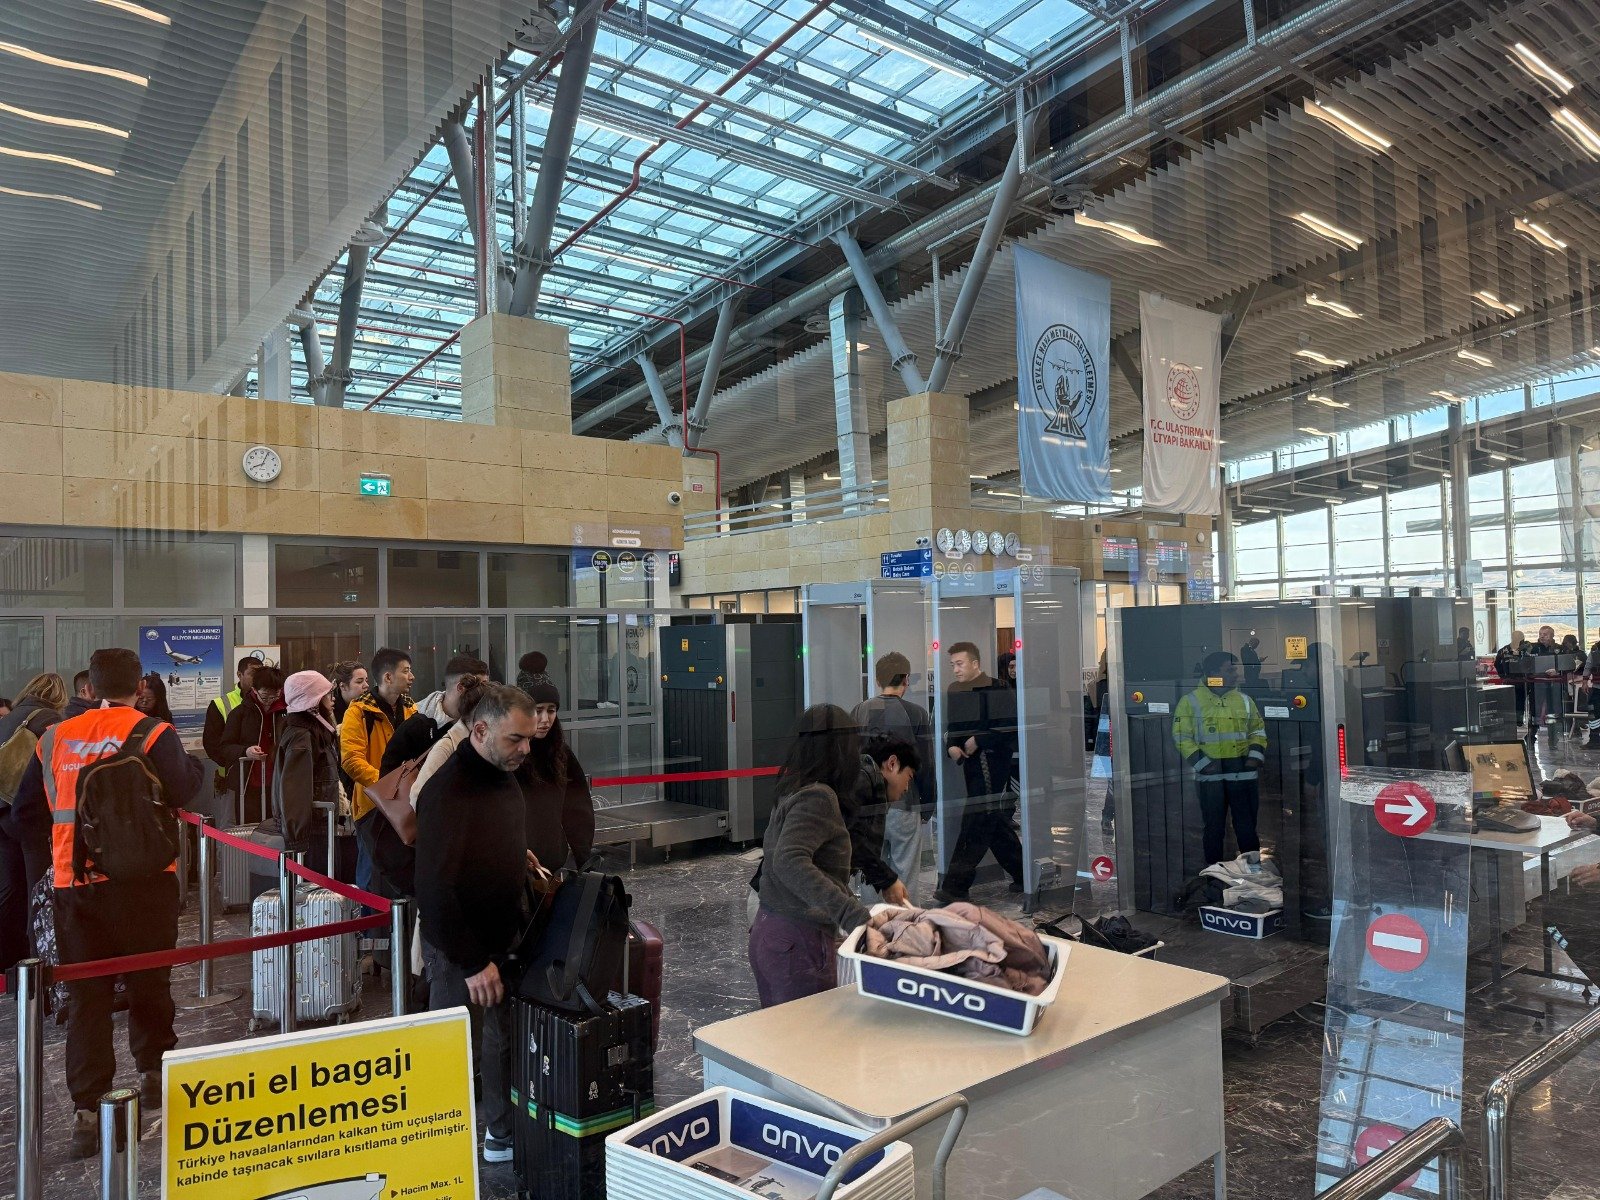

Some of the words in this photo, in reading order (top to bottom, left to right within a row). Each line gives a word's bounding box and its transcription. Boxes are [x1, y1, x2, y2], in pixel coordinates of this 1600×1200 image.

[1035, 354, 1043, 391] DEVLET
[1153, 433, 1178, 446] LTYAPI
[897, 978, 986, 1012] onvo
[181, 1072, 255, 1108] Yeni
[268, 1065, 297, 1095] el
[311, 1048, 411, 1087] bagajı
[177, 1154, 225, 1170] Türkiye
[229, 1134, 335, 1161] havaalanlarından
[339, 1125, 378, 1139] kalkan
[381, 1121, 403, 1132] tüm
[407, 1109, 462, 1127] uçuşlarda
[184, 1085, 407, 1151] Düzenlemesi
[177, 1168, 228, 1187] kabinde
[233, 1155, 293, 1176] taşınacak
[297, 1148, 340, 1163] sıvılara
[344, 1138, 397, 1154] kısıtlama
[401, 1123, 468, 1145] getirilmiştir.
[401, 1184, 429, 1196] Hacim
[430, 1180, 451, 1191] Max.
[454, 1176, 464, 1185] 1L
